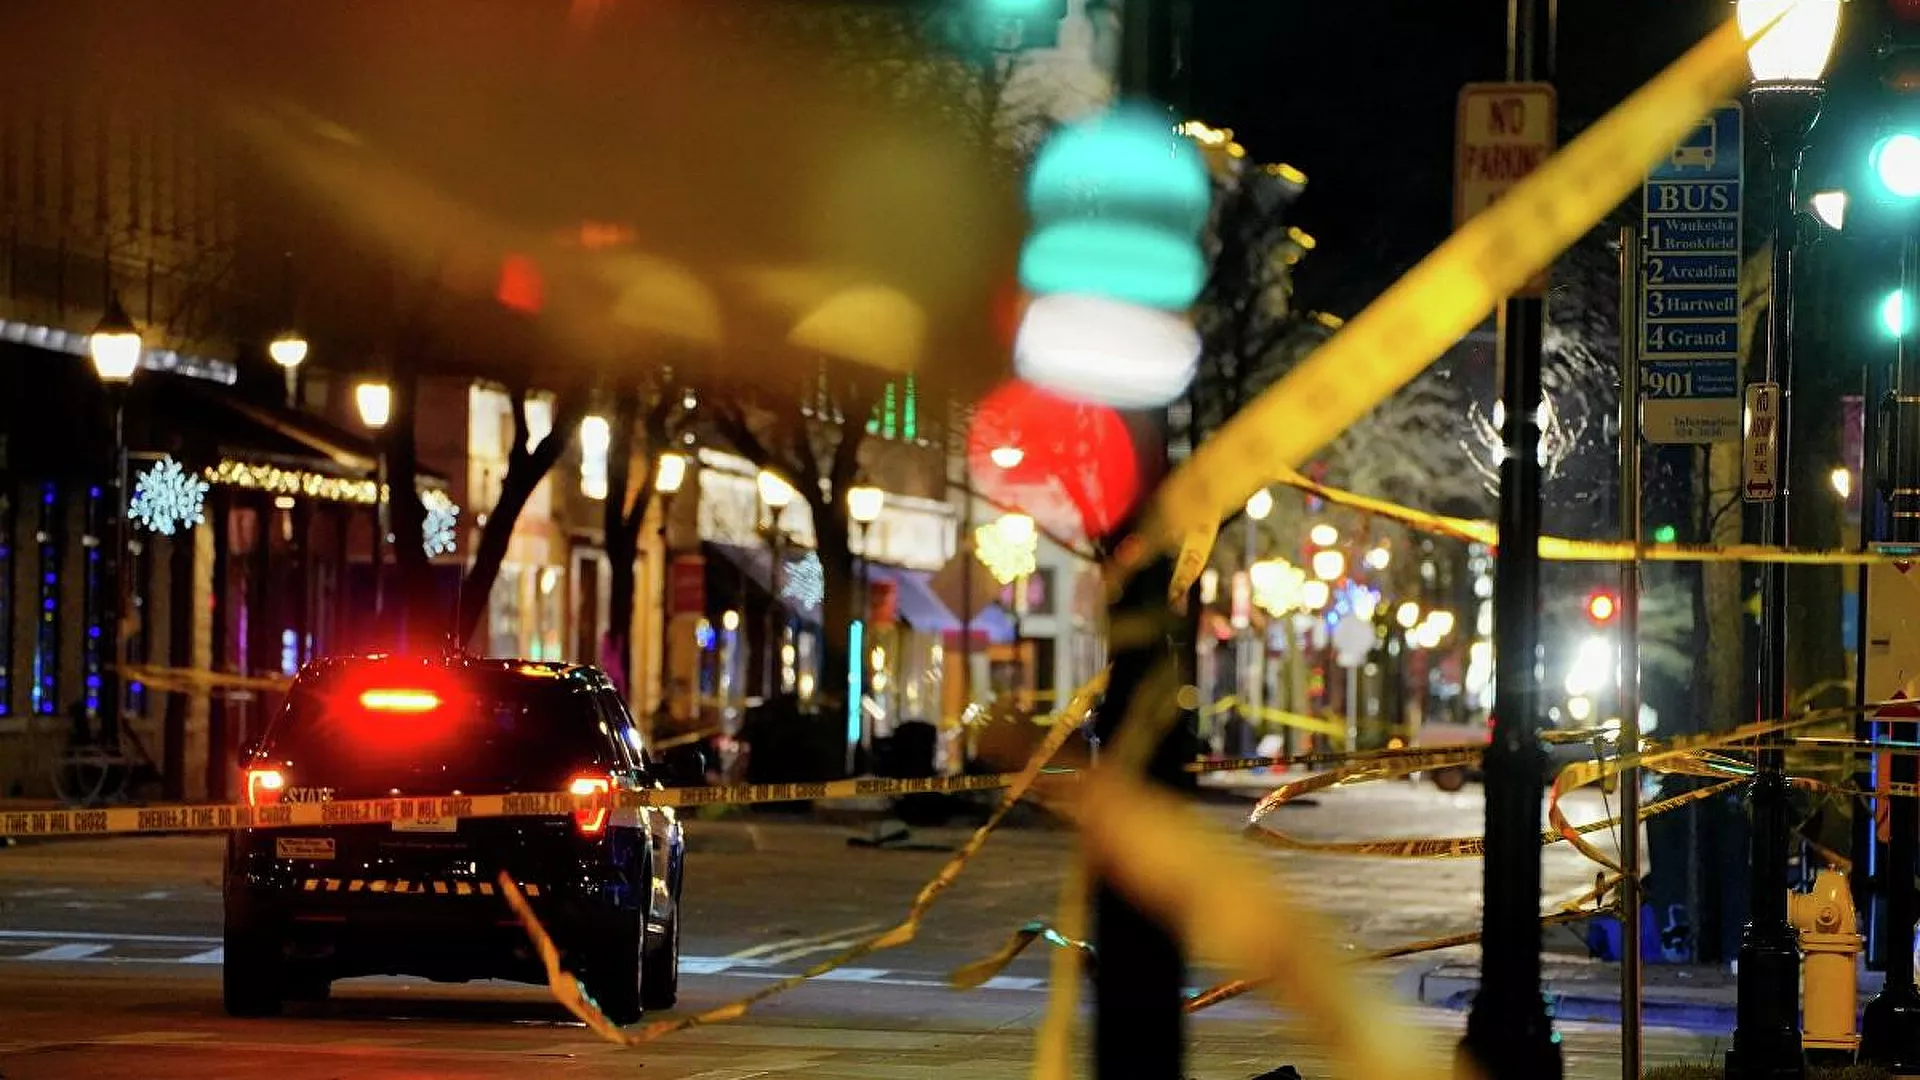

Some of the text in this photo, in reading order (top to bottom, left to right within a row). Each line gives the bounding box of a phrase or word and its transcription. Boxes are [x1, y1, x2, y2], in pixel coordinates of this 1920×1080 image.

[1487, 97, 1526, 136] NO
[1657, 185, 1729, 211] BUS
[1651, 224, 1661, 249] 1
[1665, 219, 1734, 231] Waukesha
[1665, 236, 1734, 249] Brookfield
[1649, 258, 1736, 283] 2 Arcadian
[1648, 291, 1734, 316] 3 Hartwell
[1649, 325, 1726, 350] 4 Grand
[1649, 371, 1693, 397] 901
[1756, 392, 1769, 412] NO
